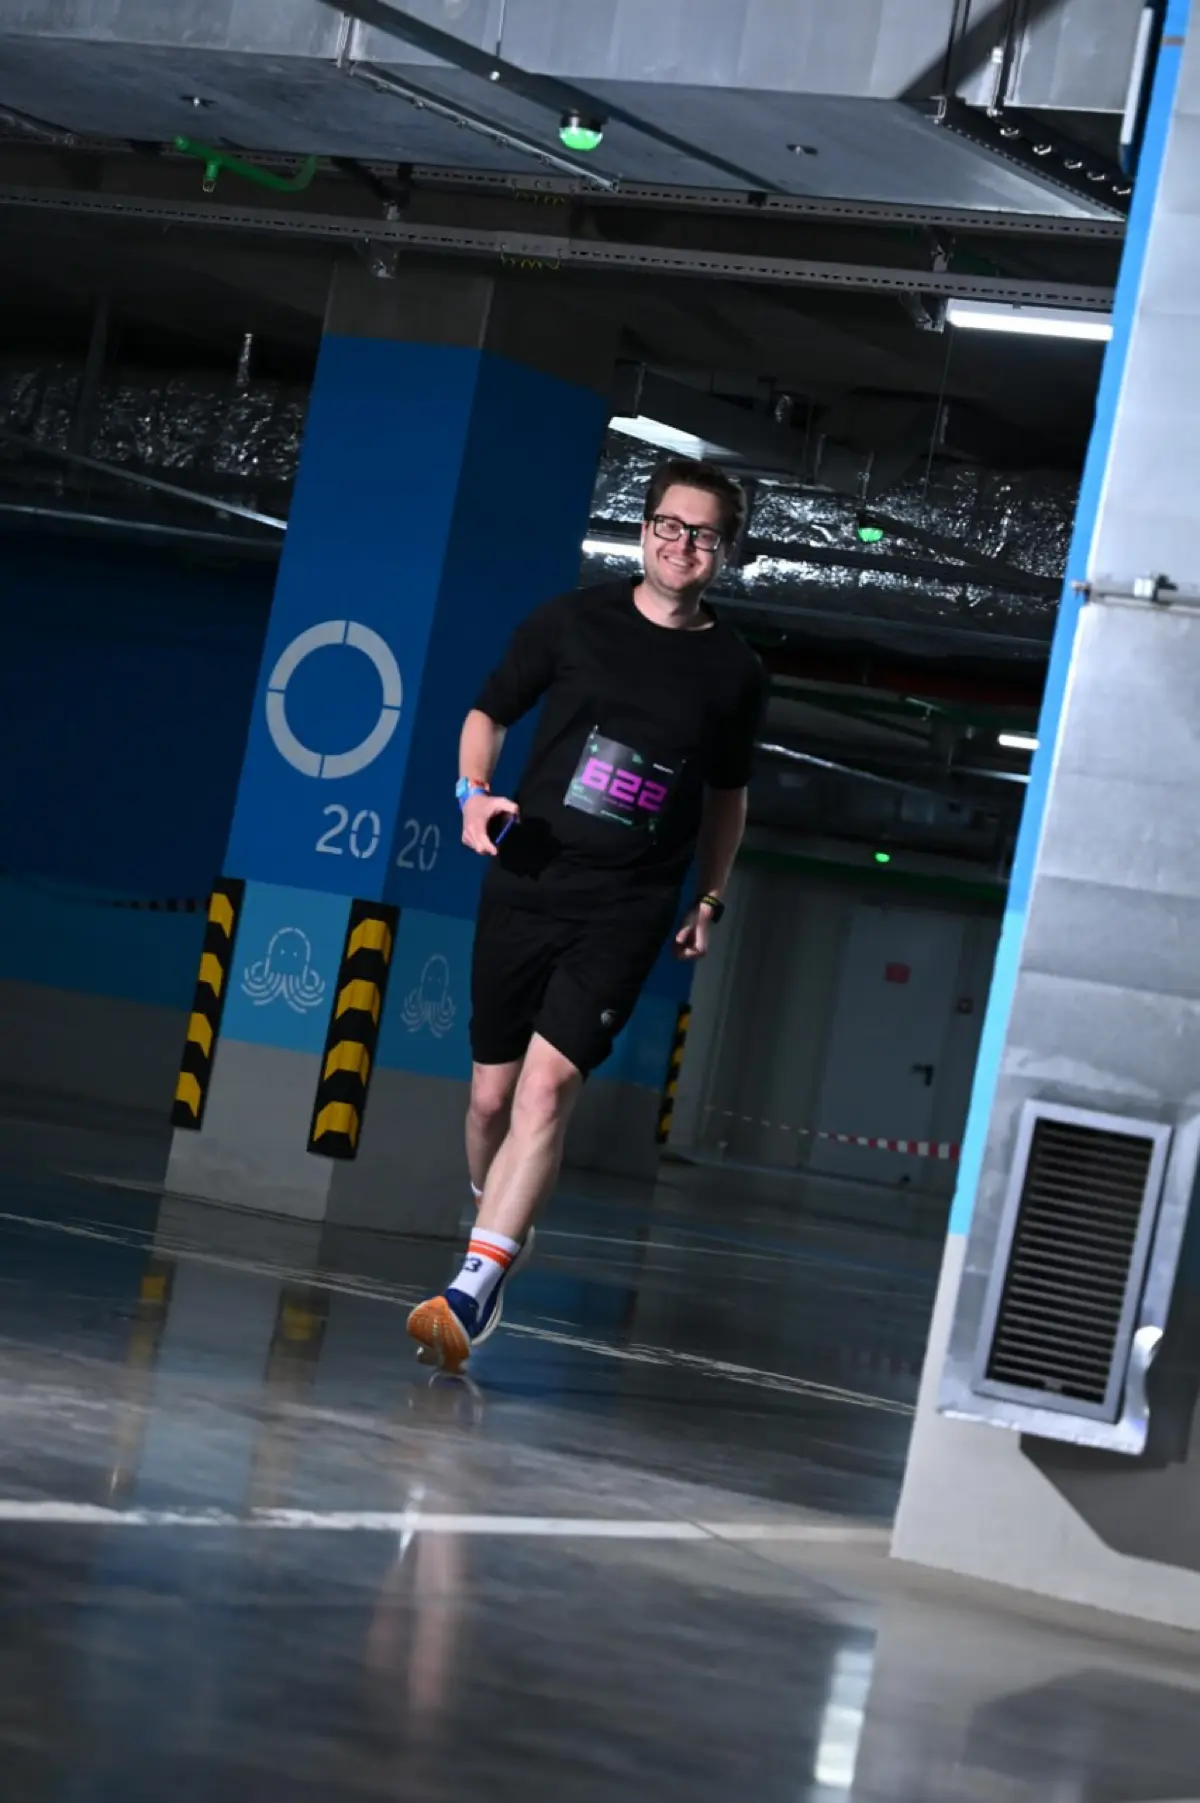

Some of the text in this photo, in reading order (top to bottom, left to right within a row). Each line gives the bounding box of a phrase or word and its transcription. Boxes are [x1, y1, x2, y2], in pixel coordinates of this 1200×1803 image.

[581, 756, 668, 812] 622
[315, 803, 381, 859] 20
[396, 818, 441, 872] 20
